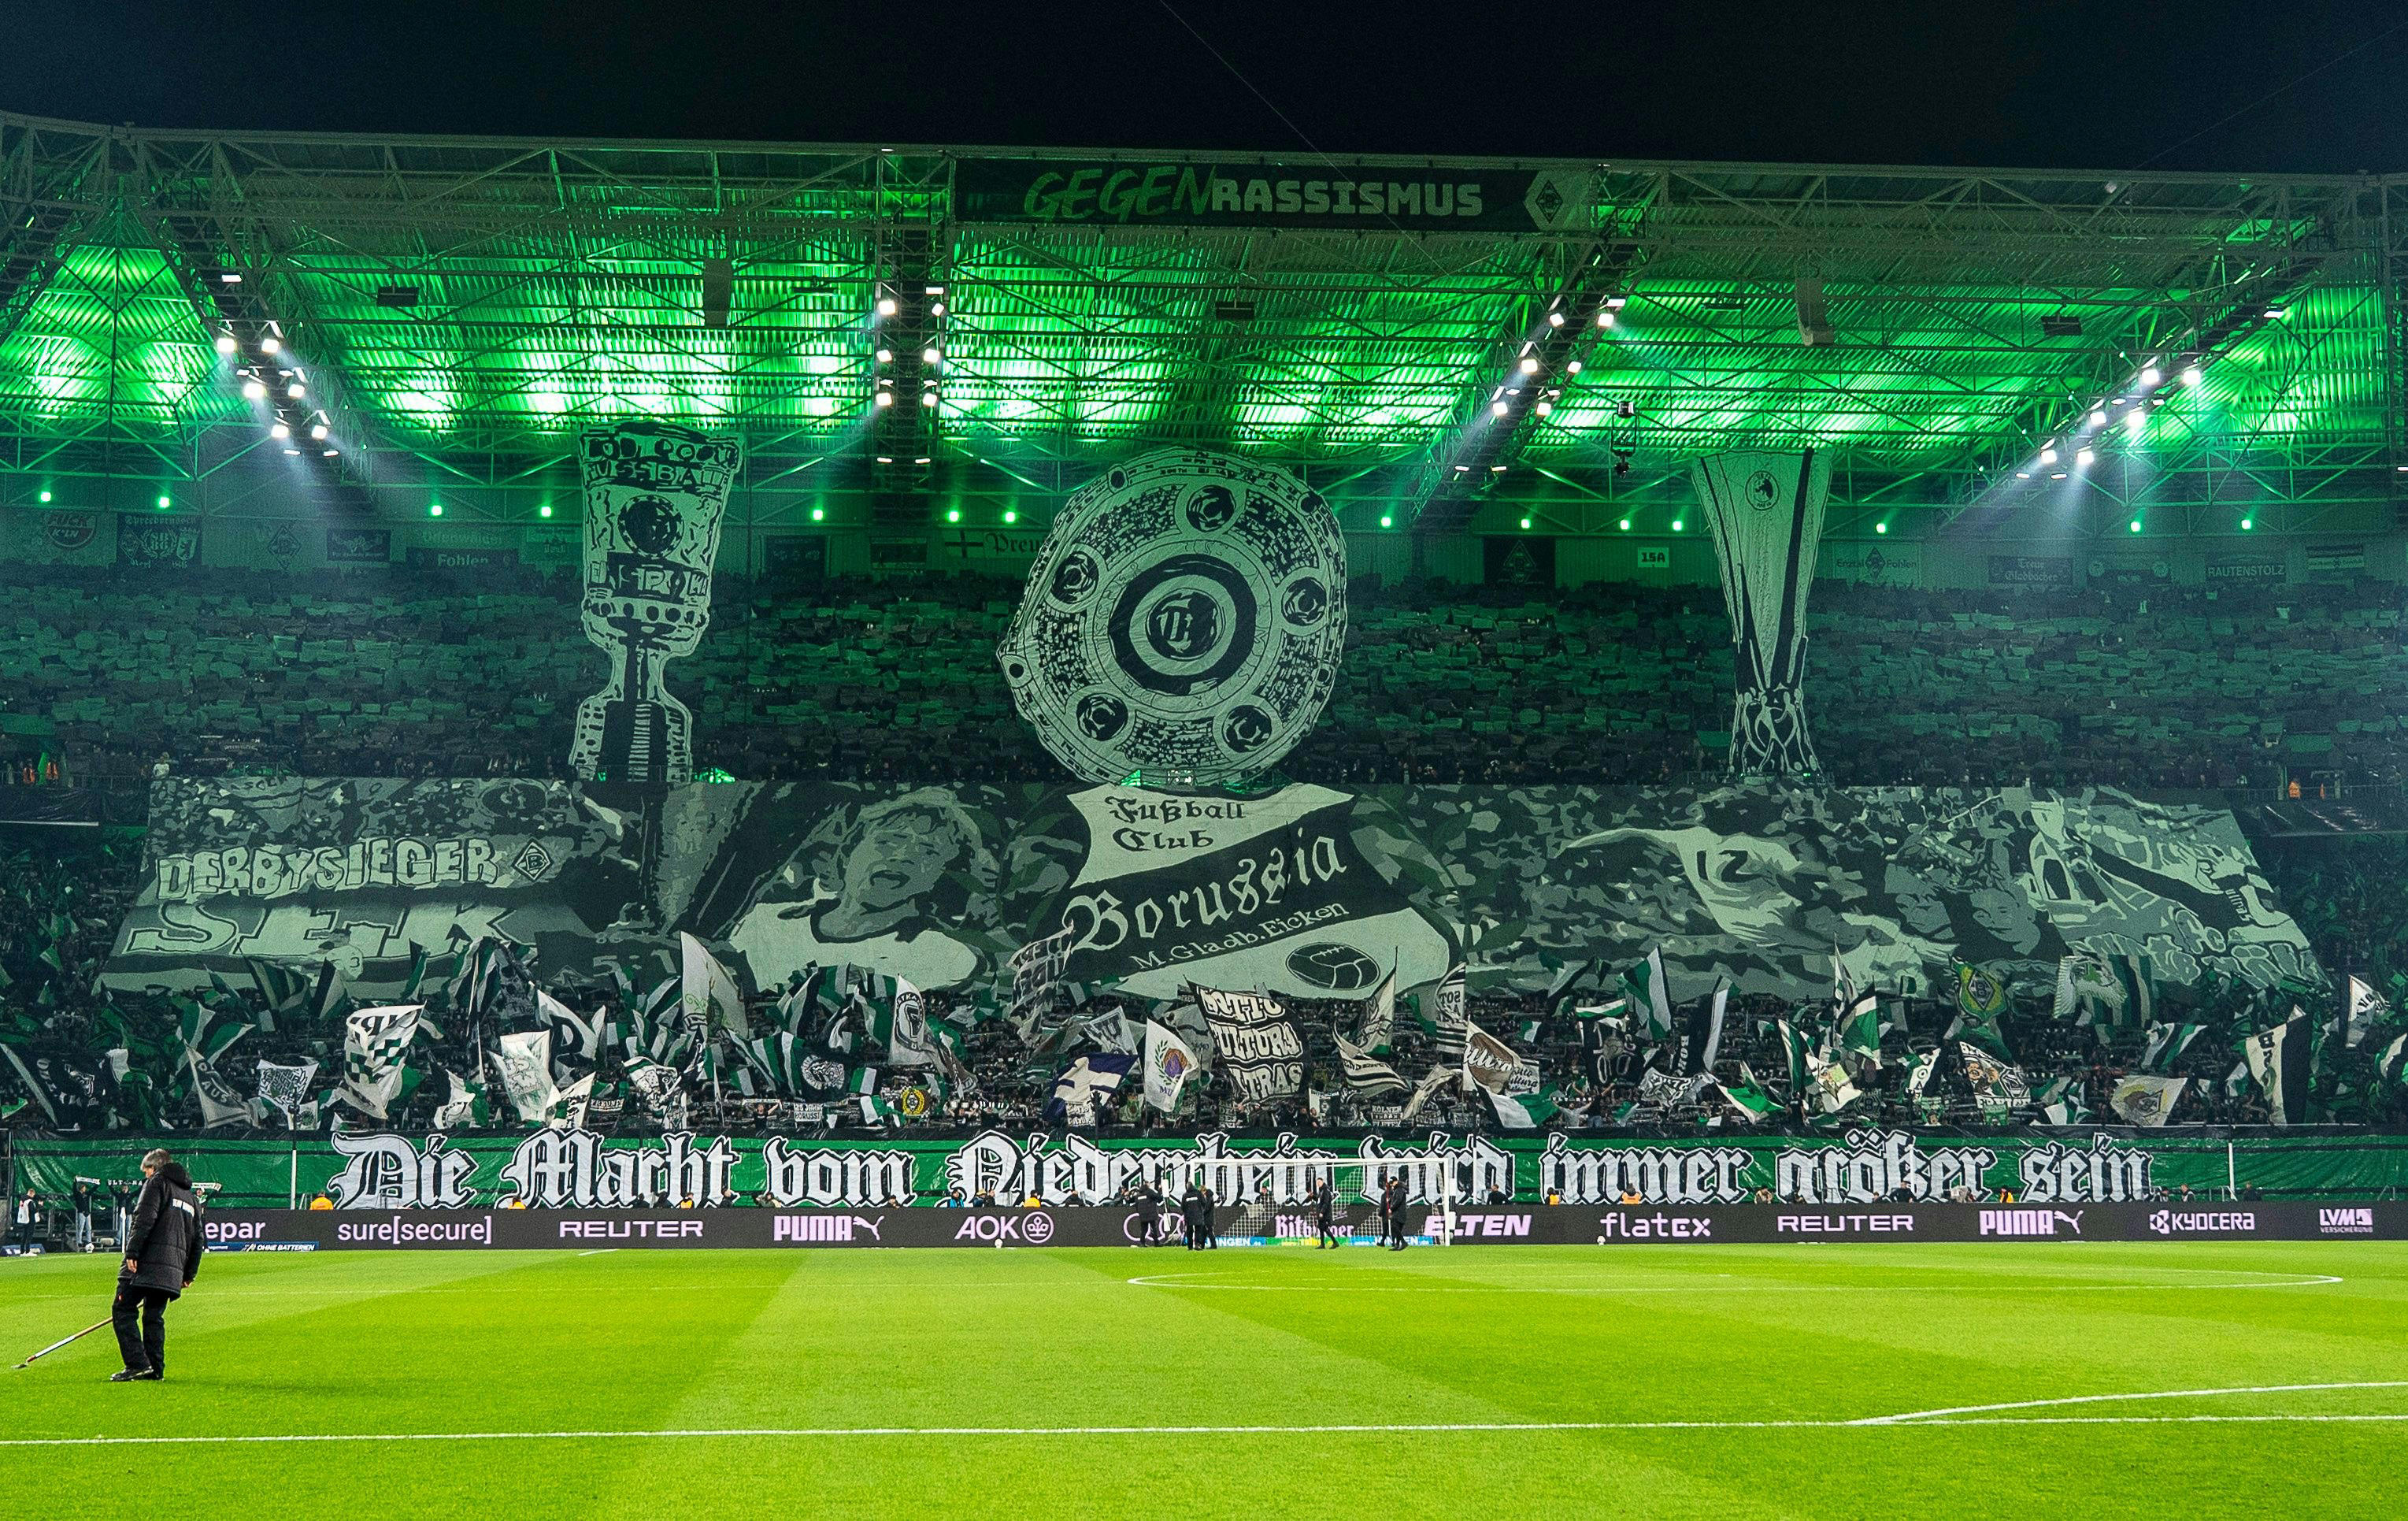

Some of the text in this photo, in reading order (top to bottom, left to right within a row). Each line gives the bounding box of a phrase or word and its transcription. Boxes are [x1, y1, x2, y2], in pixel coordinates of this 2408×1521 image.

[1024, 165, 1484, 222] GEGEN RASSISMUS
[437, 553, 489, 567] Fohlen
[1640, 552, 1667, 563] 15A
[1886, 558, 1917, 569] Fohlen
[2207, 564, 2285, 577] RAUTENSTOLZ
[1104, 795, 1247, 825] Fußball
[1112, 826, 1215, 851] Club
[156, 837, 500, 902] DERBYSIEGER
[1062, 826, 1348, 951] Borussia
[1210, 1023, 1303, 1059] ULTURA
[794, 1111, 821, 1120] BORUSSI
[328, 1127, 2156, 1209] Die Macht vom Niederrhein wird immer größer sein
[559, 1220, 704, 1237] REUTER
[773, 1215, 854, 1242] PUMA
[954, 1215, 1021, 1240] AOK
[1275, 1215, 1354, 1237] Bitbuger
[1599, 1212, 1712, 1237] flatex
[1776, 1215, 1914, 1232] REUTER
[1979, 1210, 2054, 1236] PUMA
[2170, 1212, 2256, 1231] KYOCERA
[2319, 1208, 2356, 1226] LVM
[337, 1215, 492, 1245] sure[secure]
